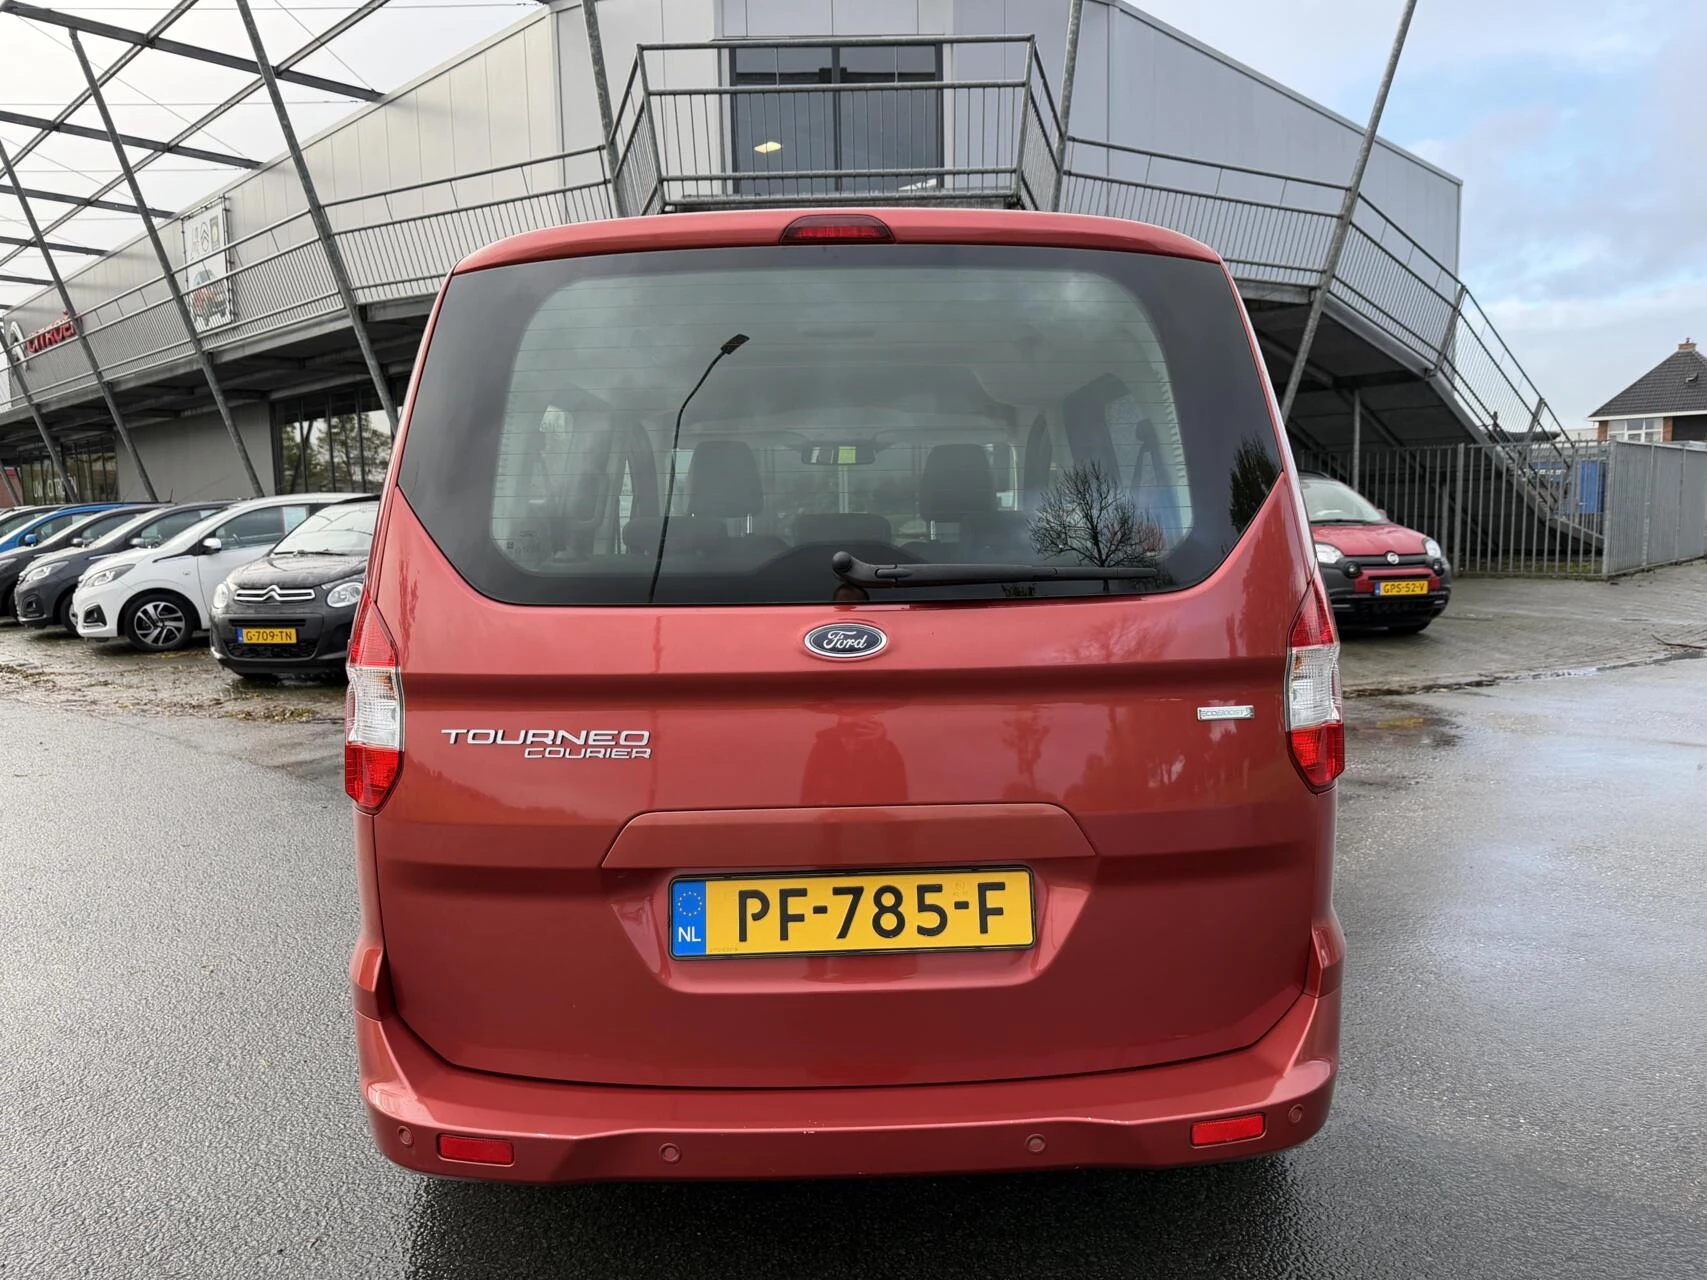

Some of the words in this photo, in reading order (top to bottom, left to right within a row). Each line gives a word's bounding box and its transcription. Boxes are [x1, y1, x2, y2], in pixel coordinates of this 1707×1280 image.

[1383, 582, 1425, 594] GPS-52-V
[245, 630, 293, 642] G-709-TN
[823, 630, 868, 649] Ford
[441, 729, 650, 746] TOURNEO
[524, 747, 651, 759] COURIER
[737, 881, 1007, 943] PF-785-F
[678, 926, 701, 942] NL
